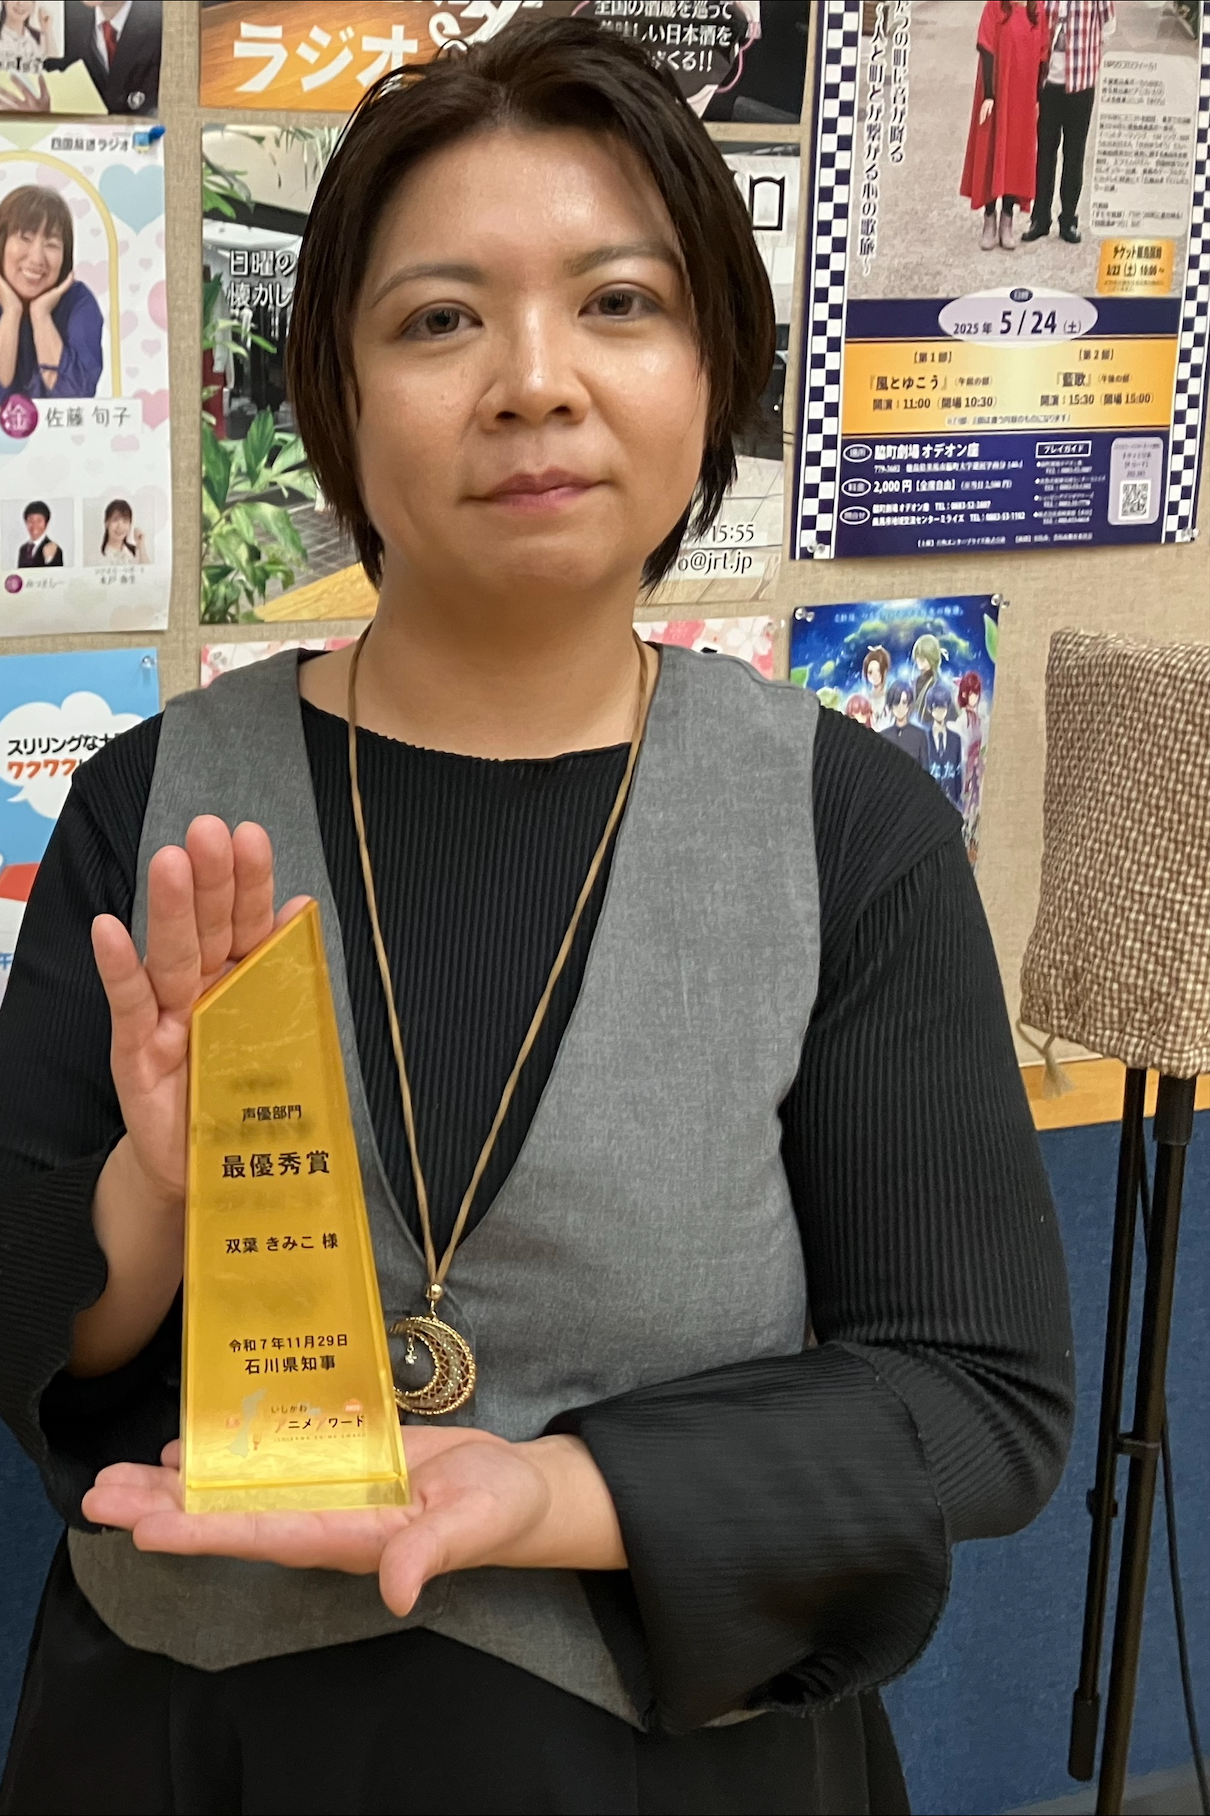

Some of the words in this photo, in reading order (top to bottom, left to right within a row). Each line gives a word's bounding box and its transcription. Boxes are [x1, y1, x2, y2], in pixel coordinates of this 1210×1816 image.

[230, 250, 298, 277] 日曜の
[46, 407, 85, 428] 佐藤
[712, 524, 754, 544] 15:55
[7, 732, 122, 756] スリリングな土
[242, 1104, 302, 1122] 声優部門
[221, 1150, 330, 1179] 最優秀賞
[225, 1237, 259, 1254] 双葉
[265, 1236, 315, 1251] きみこ
[322, 1233, 339, 1250] 様
[228, 1334, 349, 1353] 令和7年11月29日
[244, 1355, 336, 1375] 石川県知事
